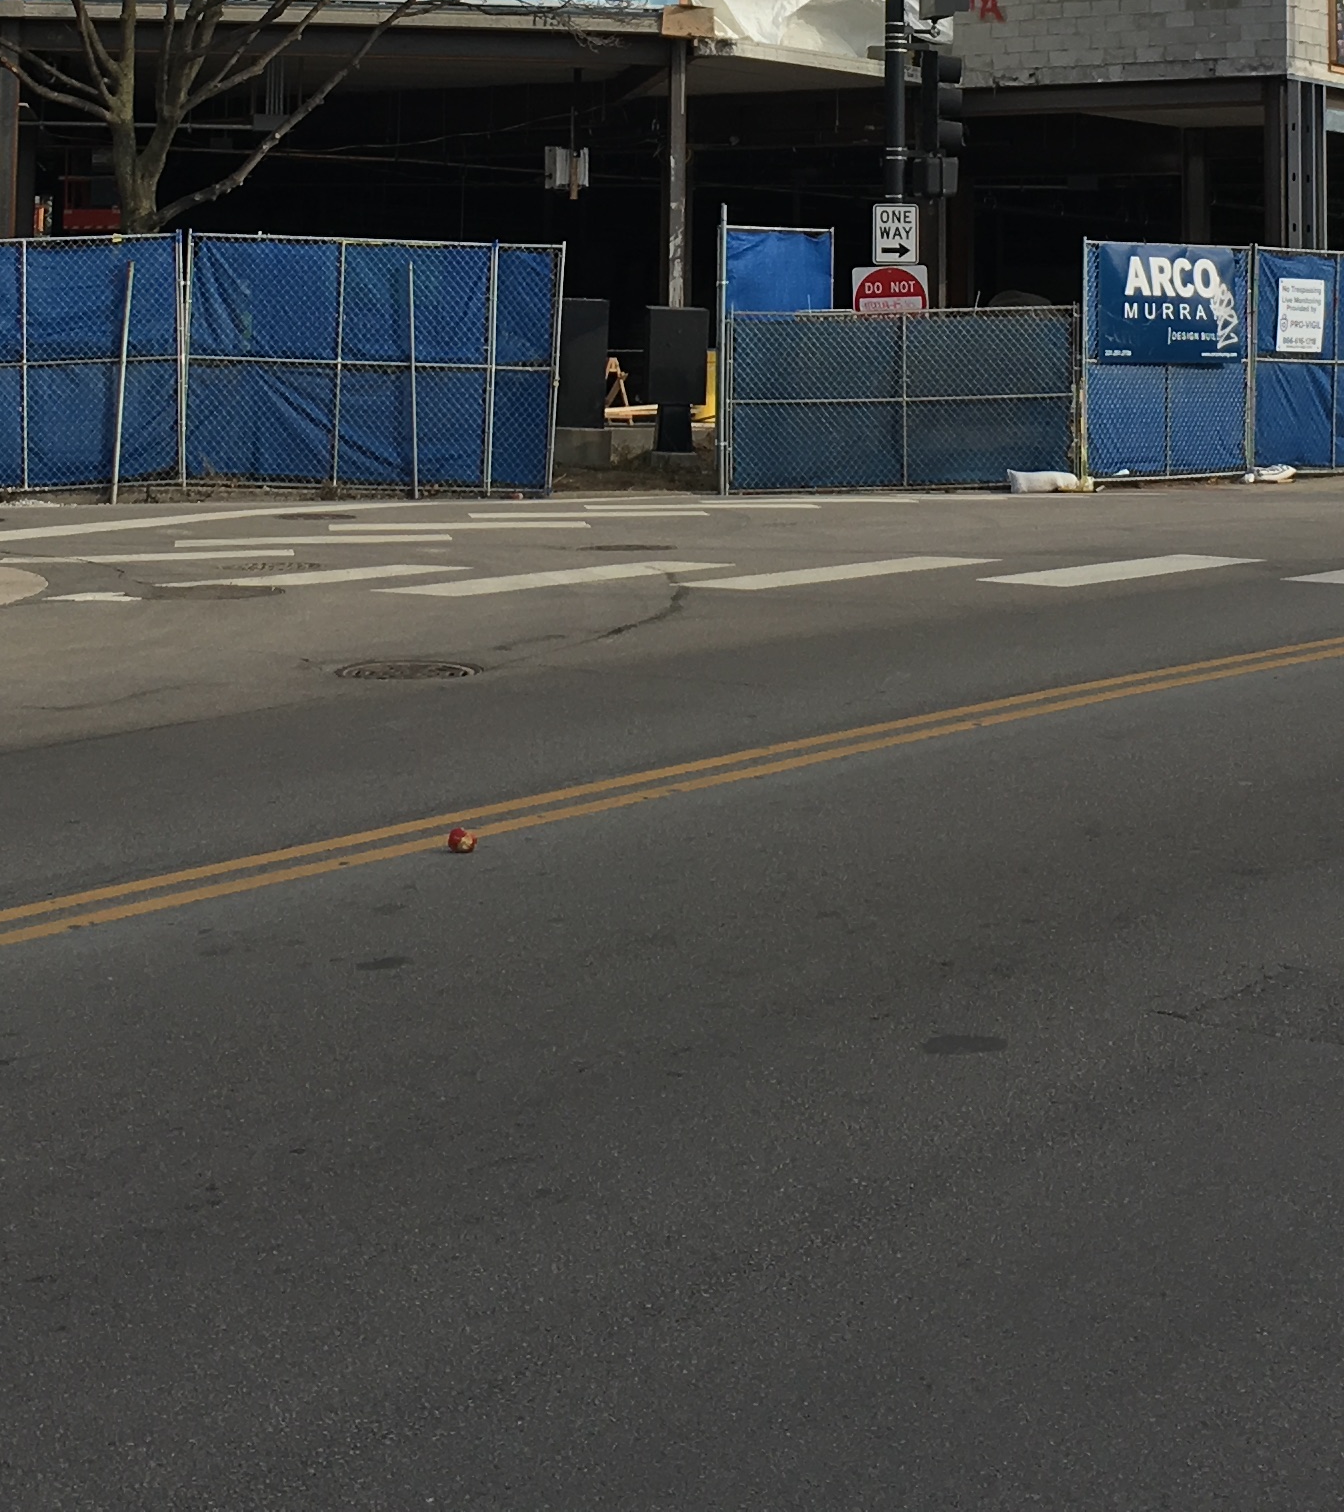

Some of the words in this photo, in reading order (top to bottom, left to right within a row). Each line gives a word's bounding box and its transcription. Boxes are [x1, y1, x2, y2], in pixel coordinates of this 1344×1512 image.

[880, 210, 912, 224] ONE
[879, 226, 913, 240] WAY
[1124, 256, 1218, 298] ARCO
[865, 283, 882, 293] DO
[891, 281, 916, 292] NOT
[1291, 286, 1321, 295] Trespassing
[1294, 297, 1321, 306] Monitoring
[1286, 304, 1310, 312] Provided
[1310, 306, 1317, 314] by
[1290, 320, 1321, 329] PRO-VIGIL
[1172, 332, 1199, 341] DESIGN
